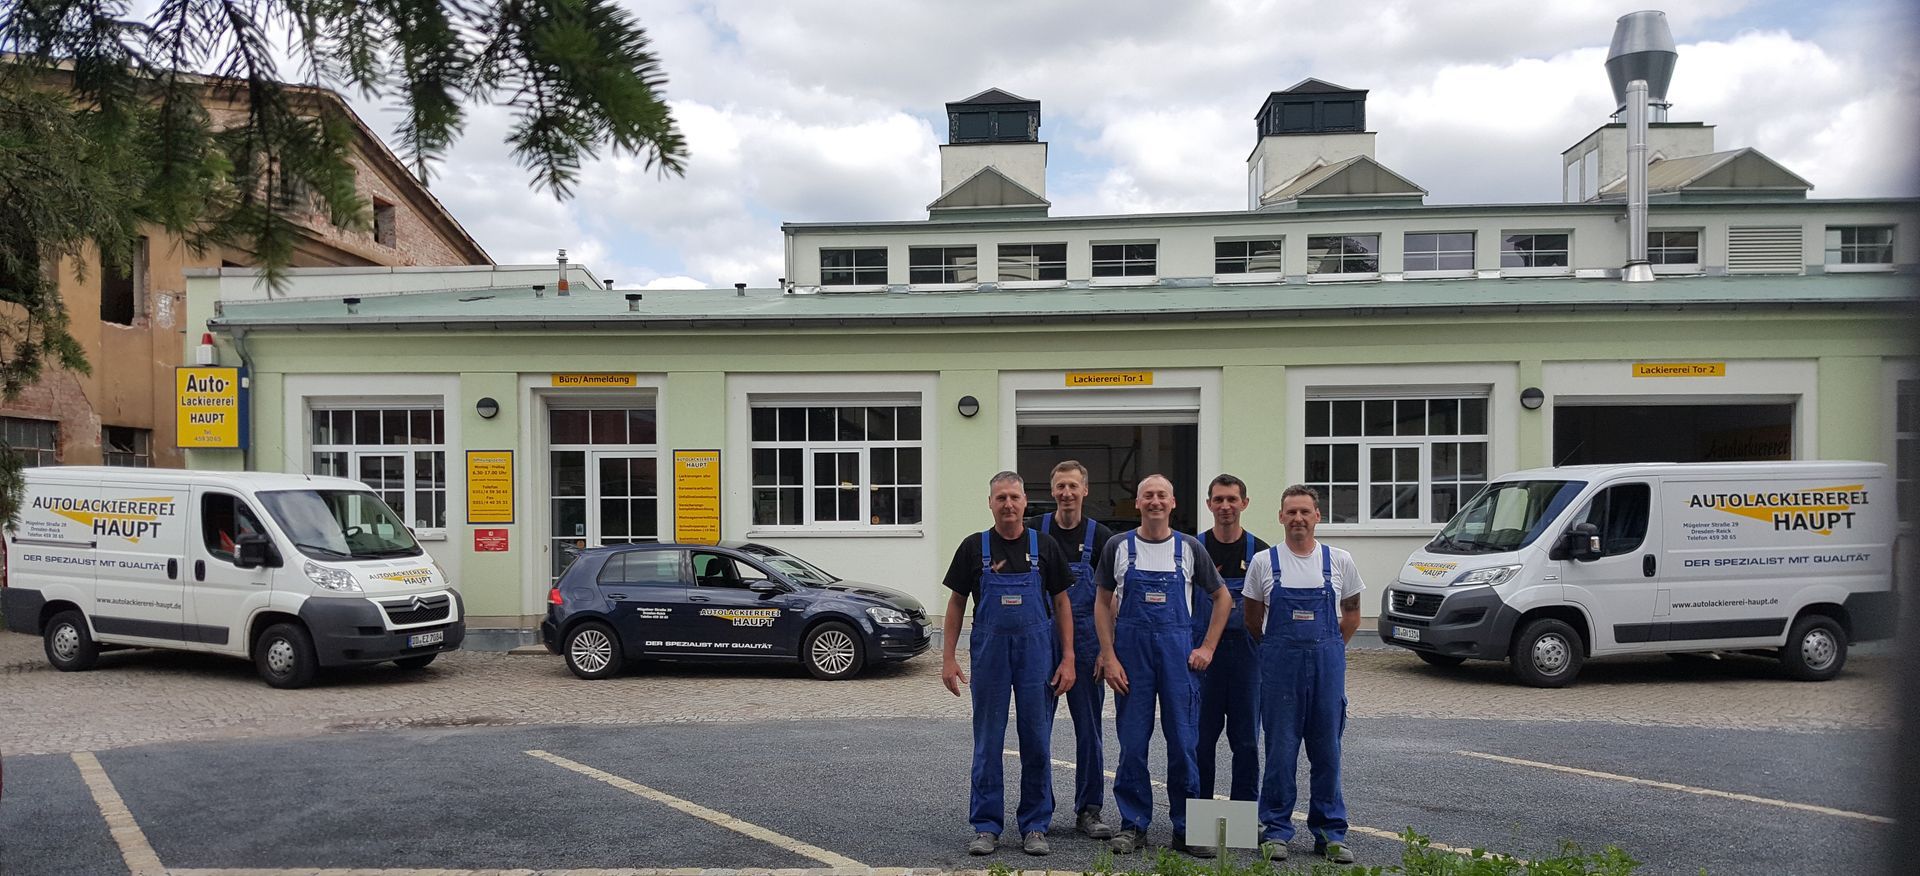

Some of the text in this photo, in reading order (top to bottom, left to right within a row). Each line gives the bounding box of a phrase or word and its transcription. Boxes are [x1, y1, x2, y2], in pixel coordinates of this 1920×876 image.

[1640, 366, 1690, 374] Lackiererei
[559, 376, 630, 384] Büro/Anmeldung
[1073, 375, 1120, 383] Lackiererei
[181, 396, 234, 406] Lackiererei
[190, 413, 225, 423] HAUPT
[1689, 491, 1869, 508] AUTOLACKIEREREI
[33, 496, 176, 516] AUTOLACKIEREREI
[1774, 512, 1856, 531] HAUPT
[93, 519, 162, 538] HAUPT
[23, 554, 166, 571] DER SPEZIALIST MIT QUALITÄT
[1408, 561, 1457, 570] AUTOLACKIEREREI
[1684, 554, 1871, 567] DER SPEZIALIST MIT QUALITÄT
[369, 568, 433, 580] AUTOLACKIEREREI
[1422, 569, 1447, 577] HAUPT
[404, 576, 432, 585] HAUPT
[96, 597, 182, 610] www.autolackiererei-haupt.de
[1672, 597, 1779, 609] www.autolackiererei-haupt.de
[700, 608, 781, 617] AUTOLACKIEREREI
[732, 617, 775, 627] HAUPT
